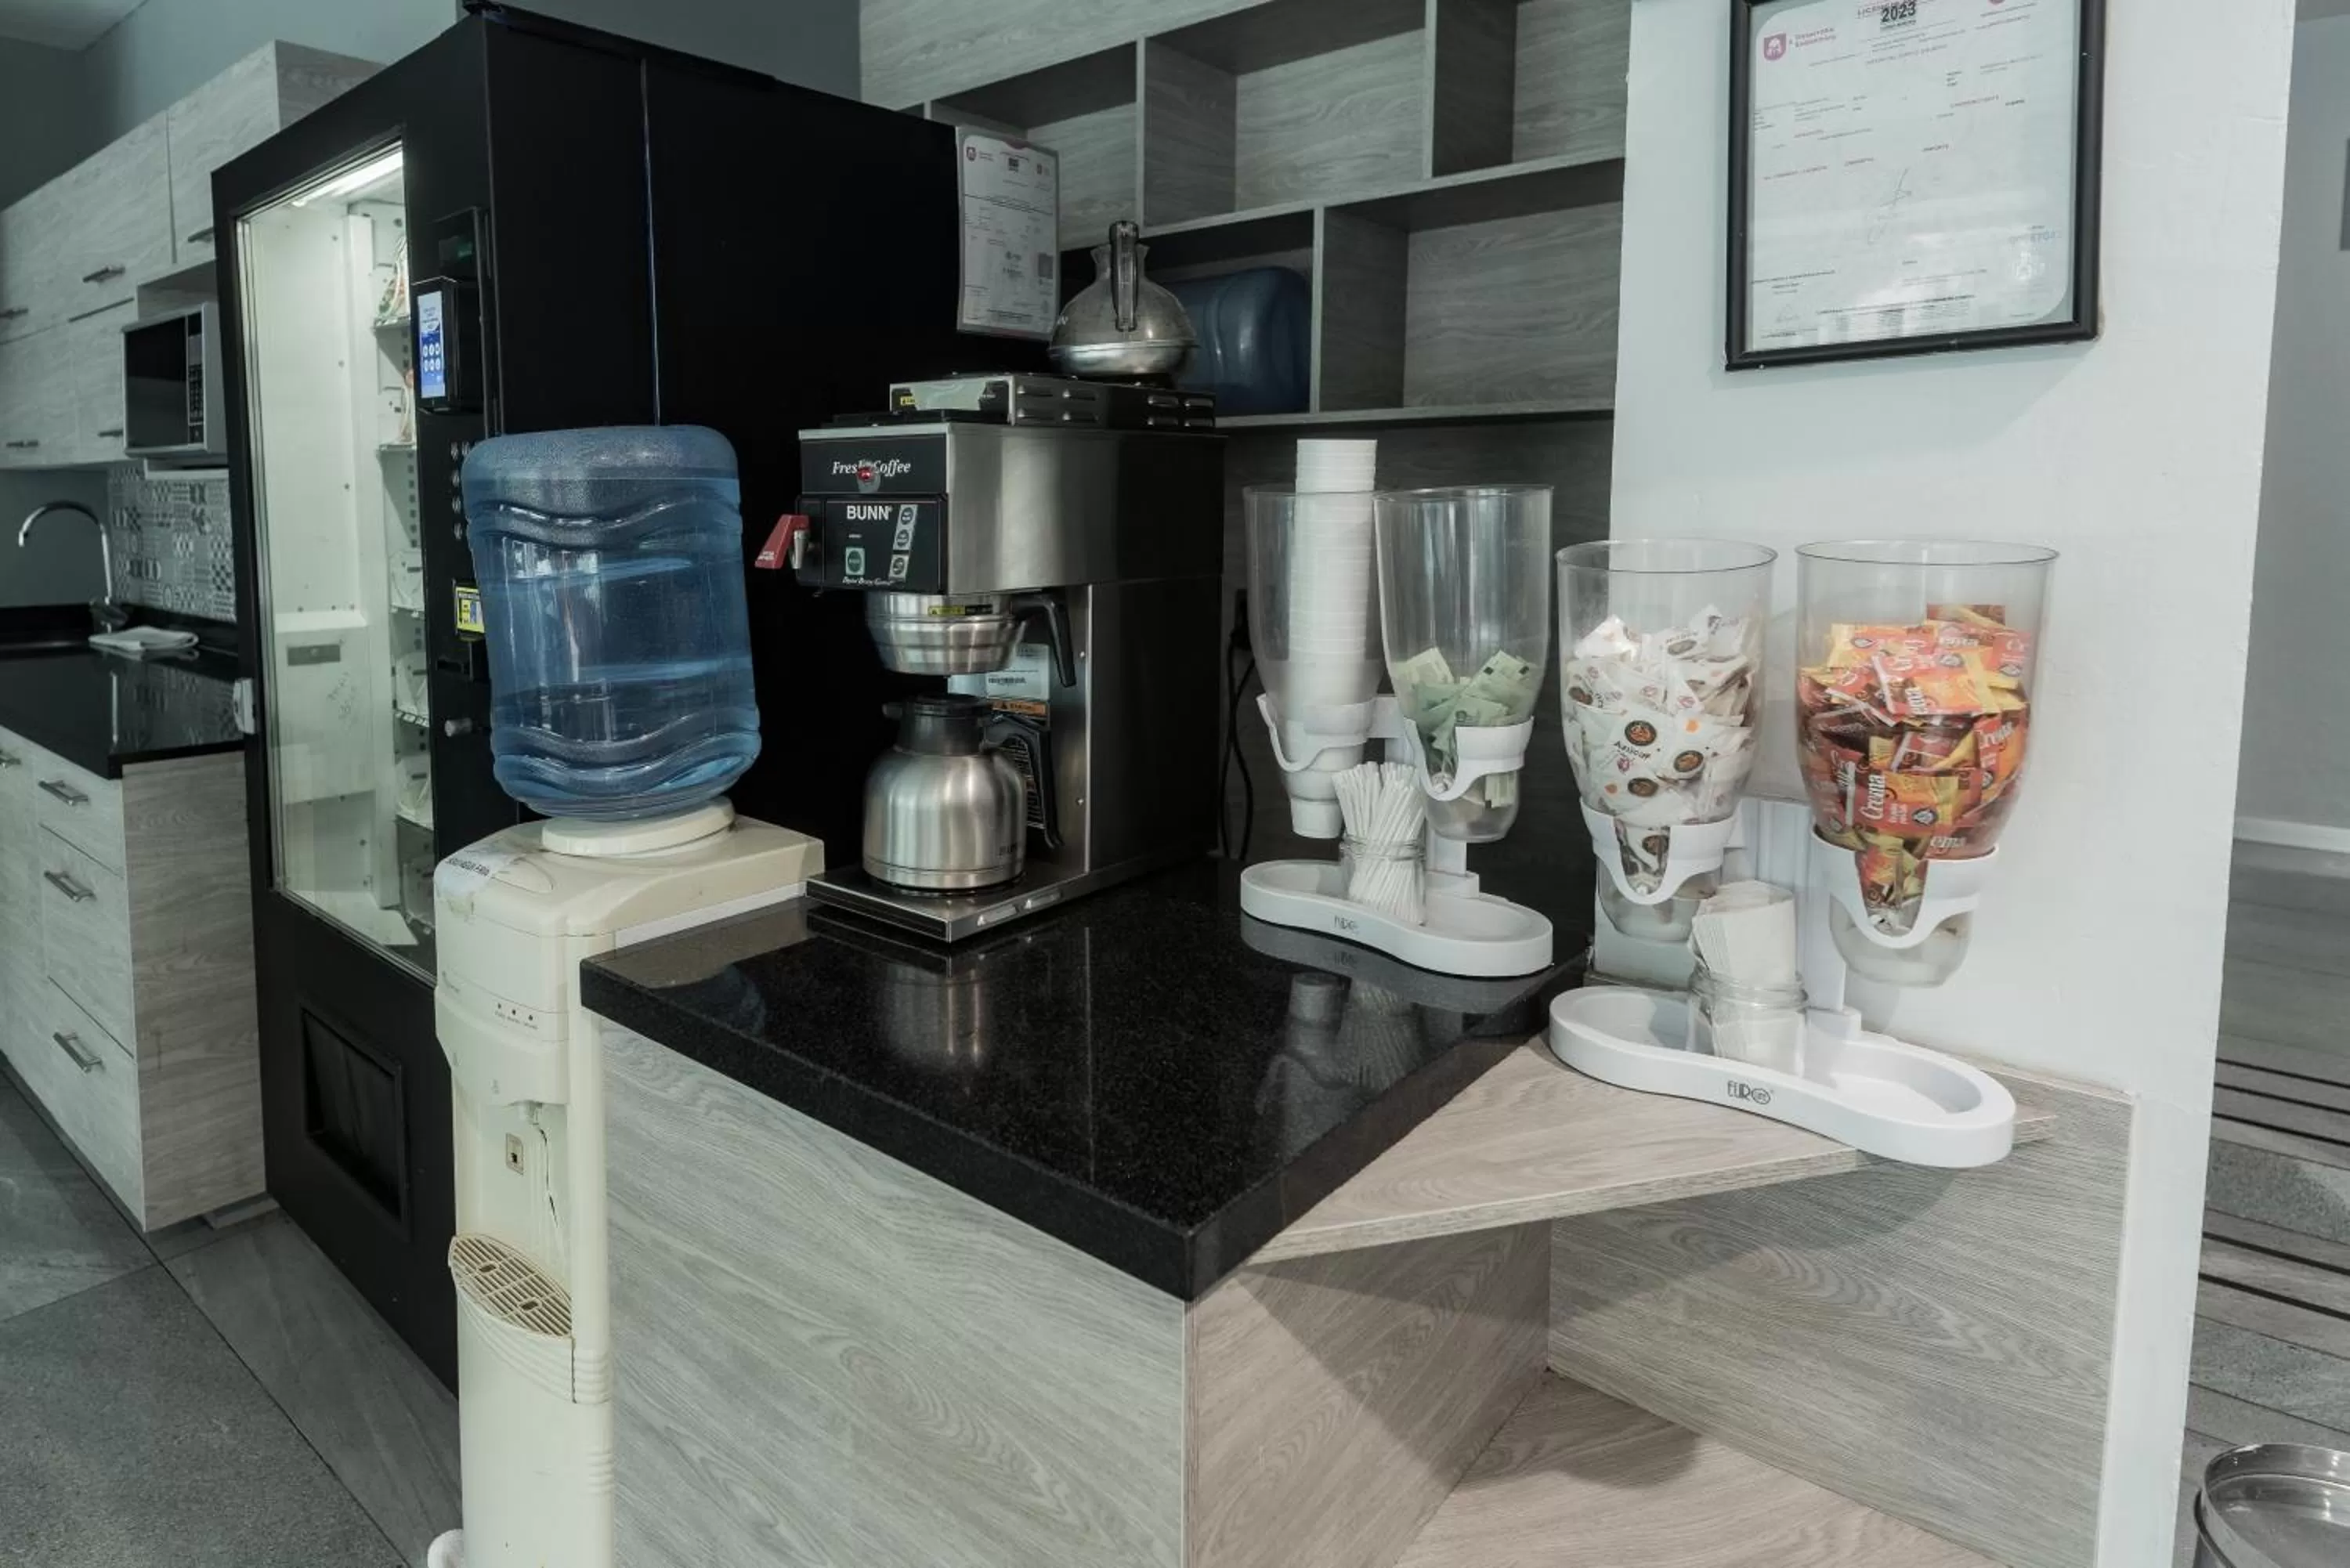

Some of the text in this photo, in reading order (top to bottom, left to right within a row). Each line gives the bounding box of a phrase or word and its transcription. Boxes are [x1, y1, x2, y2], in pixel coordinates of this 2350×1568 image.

[1882, 1, 1917, 22] 2023
[873, 459, 911, 477] Coffee
[847, 504, 889, 521] BUNN
[1858, 773, 1885, 820] Crema
